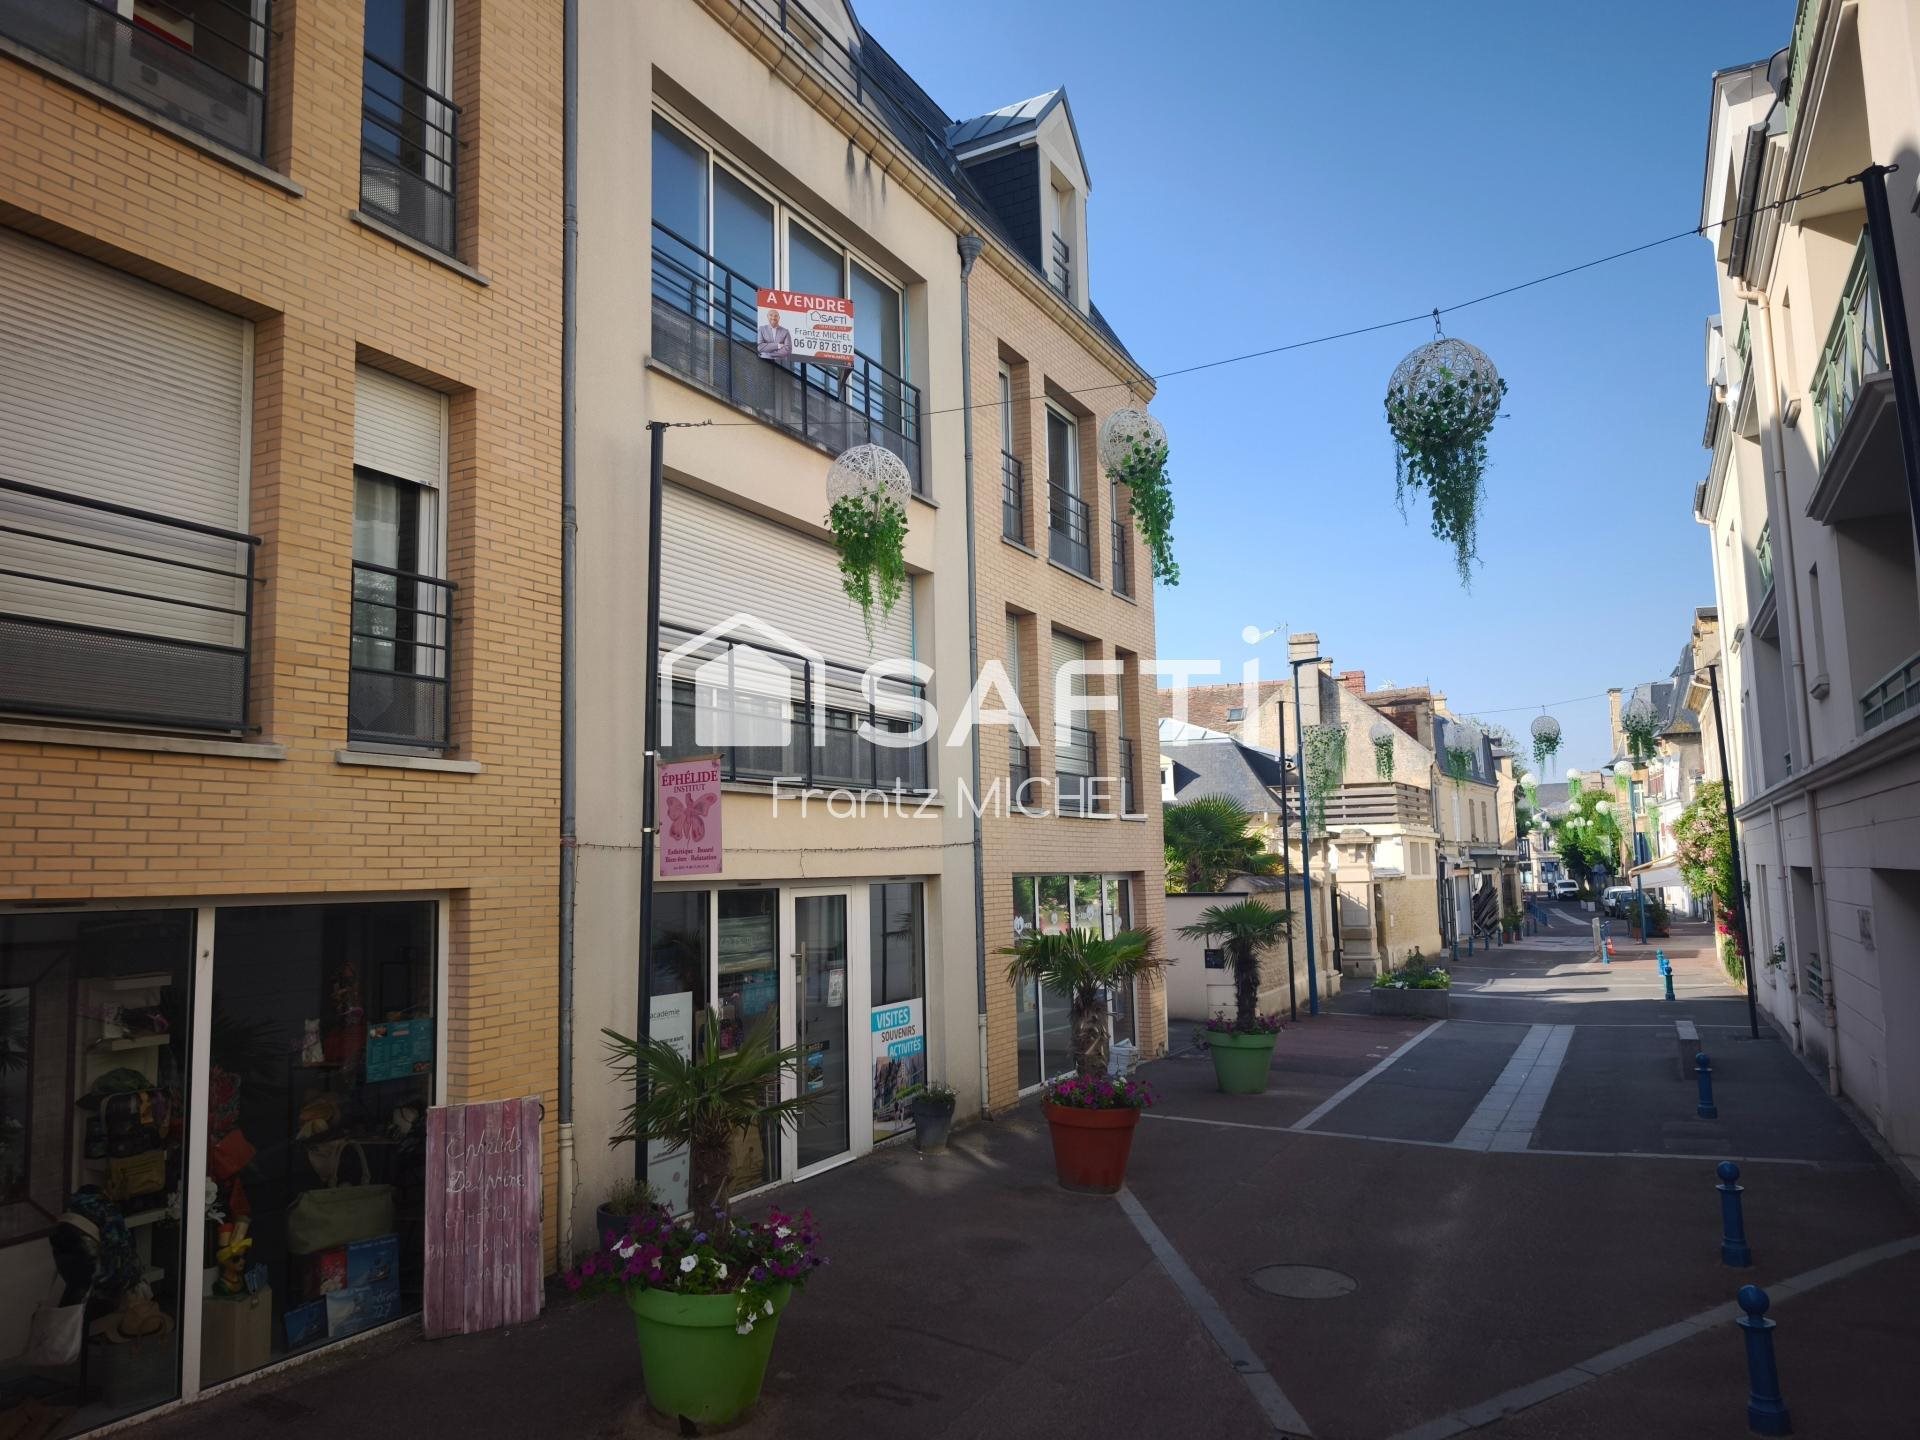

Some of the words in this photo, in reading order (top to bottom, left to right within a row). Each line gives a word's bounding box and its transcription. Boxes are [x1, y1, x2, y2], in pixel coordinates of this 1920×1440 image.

[767, 292, 777, 304] A
[783, 294, 846, 312] VENDRE
[795, 328, 820, 337] Frantz
[822, 331, 850, 341] MICHEL
[793, 338, 805, 348] 06
[807, 340, 818, 349] 07
[819, 341, 830, 351] 87
[831, 343, 840, 352] 81
[842, 344, 853, 354] 97
[661, 770, 718, 787] ÉPHÉLIDE
[673, 783, 706, 793] INSTITUT
[876, 1007, 909, 1029] VISITES
[881, 1025, 916, 1043] SOUVENIRS
[889, 1037, 922, 1057] ACTIVITÉS
